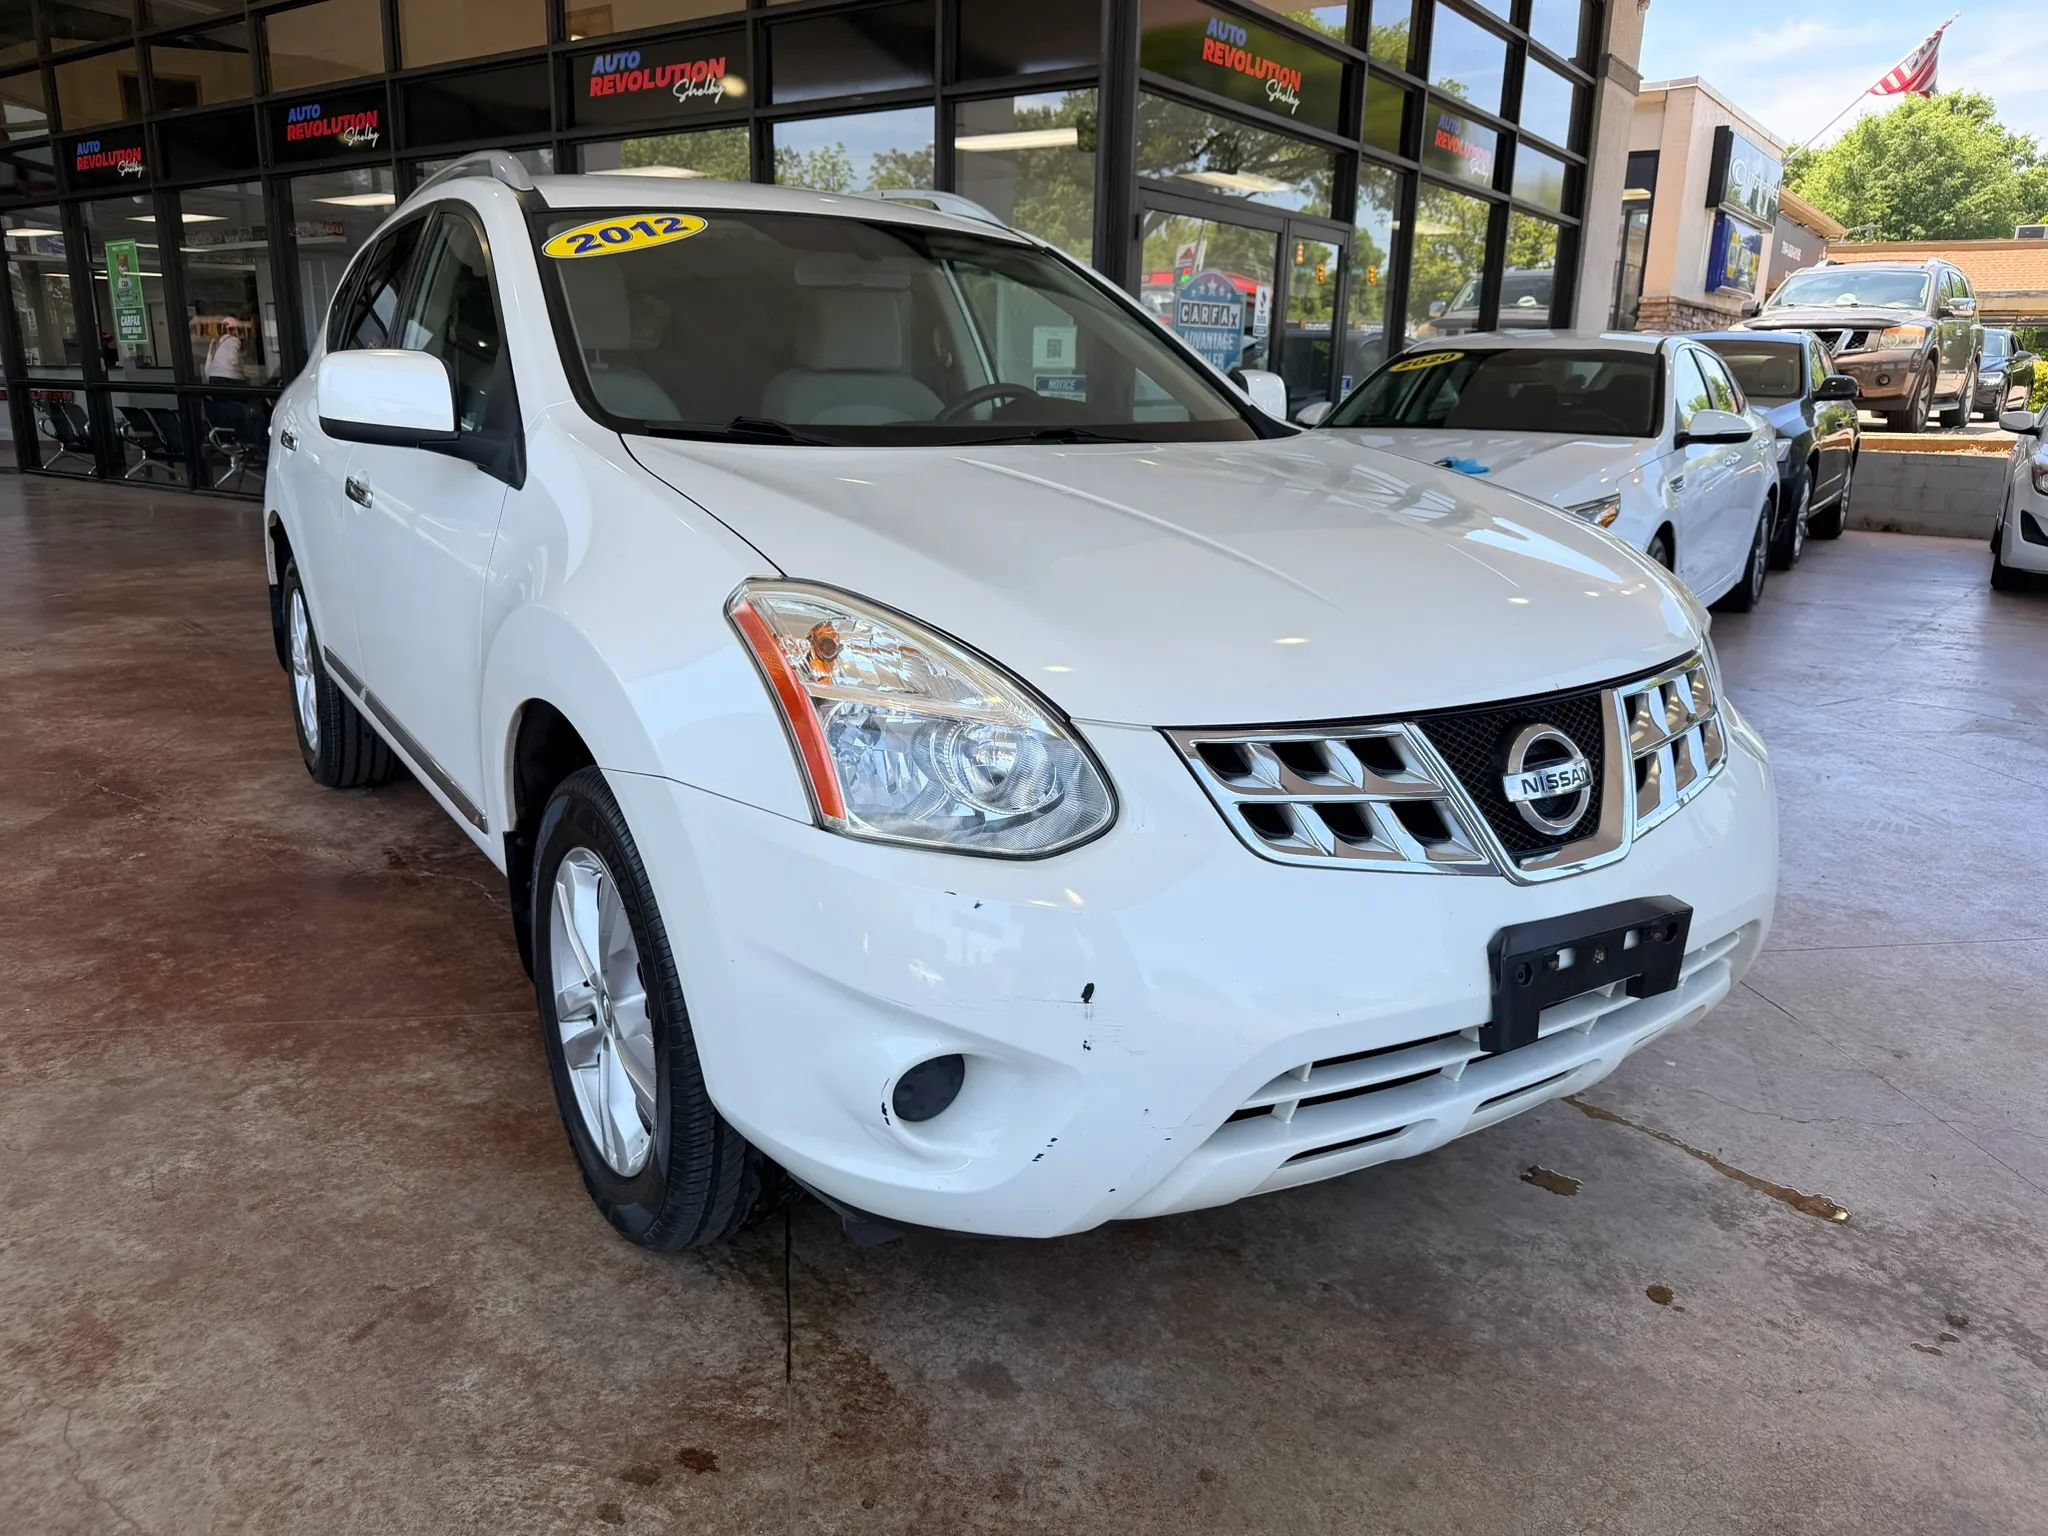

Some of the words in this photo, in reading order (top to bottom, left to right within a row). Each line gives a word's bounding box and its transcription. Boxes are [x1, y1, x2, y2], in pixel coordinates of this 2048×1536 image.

[1207, 16, 1247, 48] AUTO
[592, 51, 641, 75] AUTO
[1203, 37, 1302, 92] REVOLUTION
[590, 57, 726, 97] REVOLUTION
[672, 74, 725, 104] Shelby
[1266, 79, 1300, 115] Shelby
[288, 104, 321, 123] AUTO
[1438, 115, 1461, 135] AUTO
[287, 111, 379, 142] REVOLUTION
[343, 123, 379, 148] Shelby
[76, 147, 143, 171] REVOLUTION
[77, 141, 100, 155] AUTO
[566, 217, 692, 254] 2012
[120, 315, 141, 327] CARFAX
[1181, 303, 1239, 328] CARFAX
[1184, 331, 1234, 350] ADVANTAGE
[1397, 352, 1456, 369] 2020
[1047, 379, 1077, 391] NOTICE
[1521, 766, 1592, 795] NISSAN
